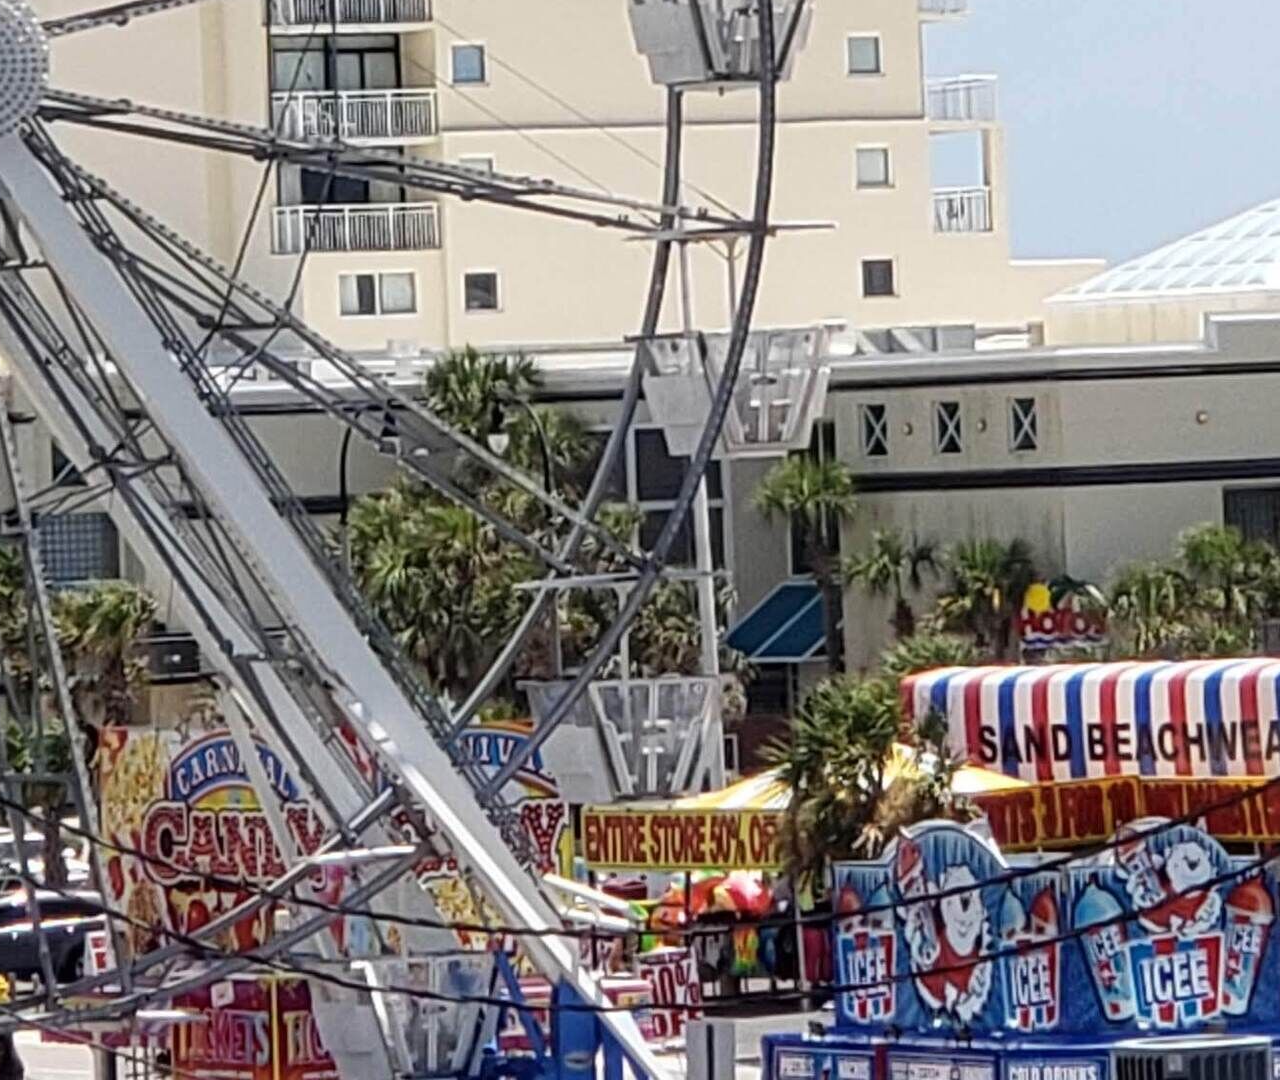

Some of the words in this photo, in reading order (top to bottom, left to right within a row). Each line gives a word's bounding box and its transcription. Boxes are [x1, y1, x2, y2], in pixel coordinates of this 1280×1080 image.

[978, 723, 1072, 763] SAND
[176, 744, 291, 798] CARNAL
[585, 814, 647, 863] ENTIRE
[650, 814, 705, 863] STORE
[709, 814, 746, 866] 50%
[848, 946, 887, 994] ICEE
[1011, 954, 1051, 1006] ICEE
[1141, 948, 1212, 1003] ICEE
